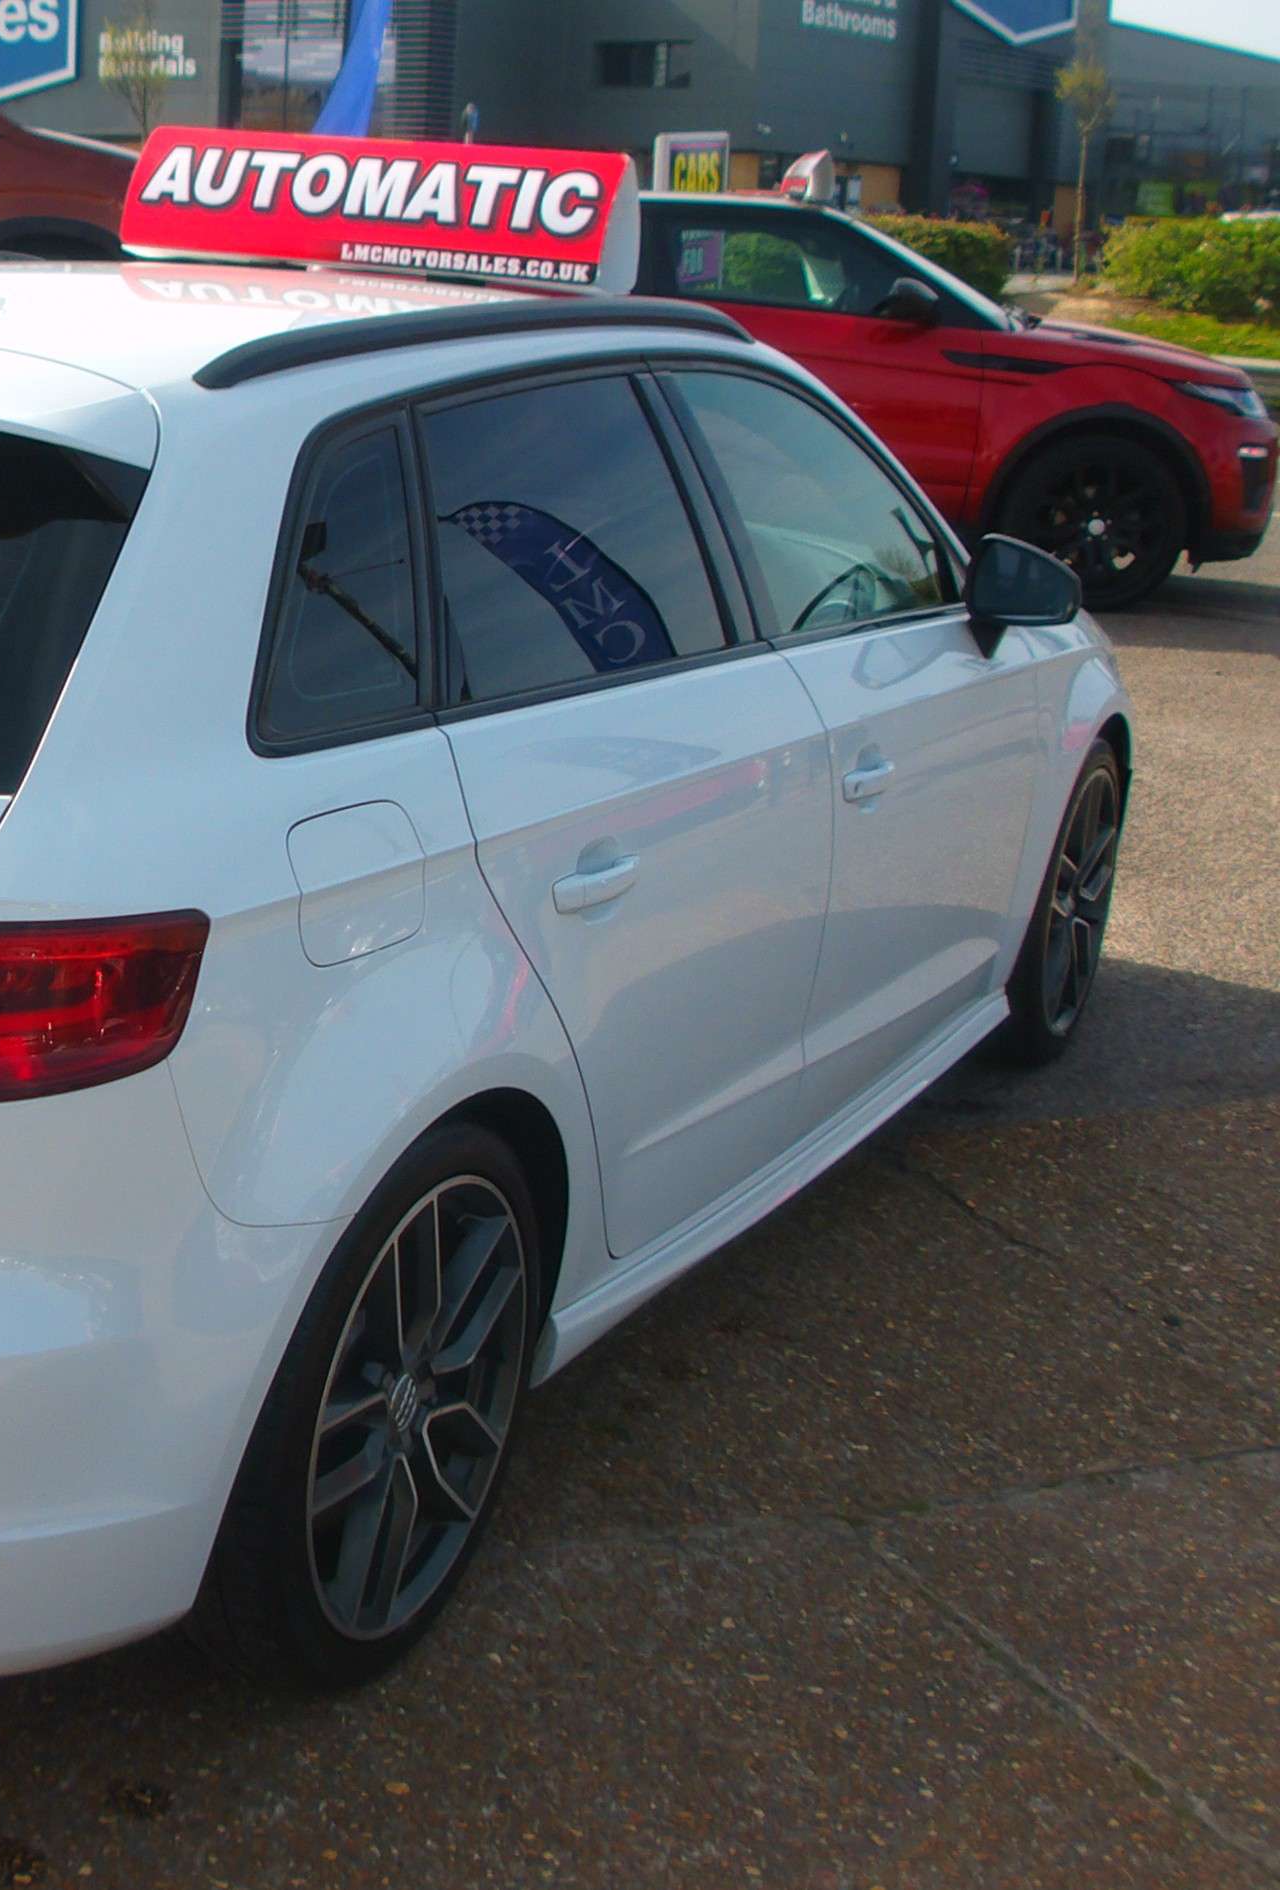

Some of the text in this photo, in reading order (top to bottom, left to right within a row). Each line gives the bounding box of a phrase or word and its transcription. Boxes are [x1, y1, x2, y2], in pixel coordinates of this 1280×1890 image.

[801, 0, 897, 39] Bathrooms
[140, 145, 601, 236] AUTOMATIC
[673, 151, 720, 192] CARS
[340, 242, 591, 282] LMCMOTORSALES.CO.UK
